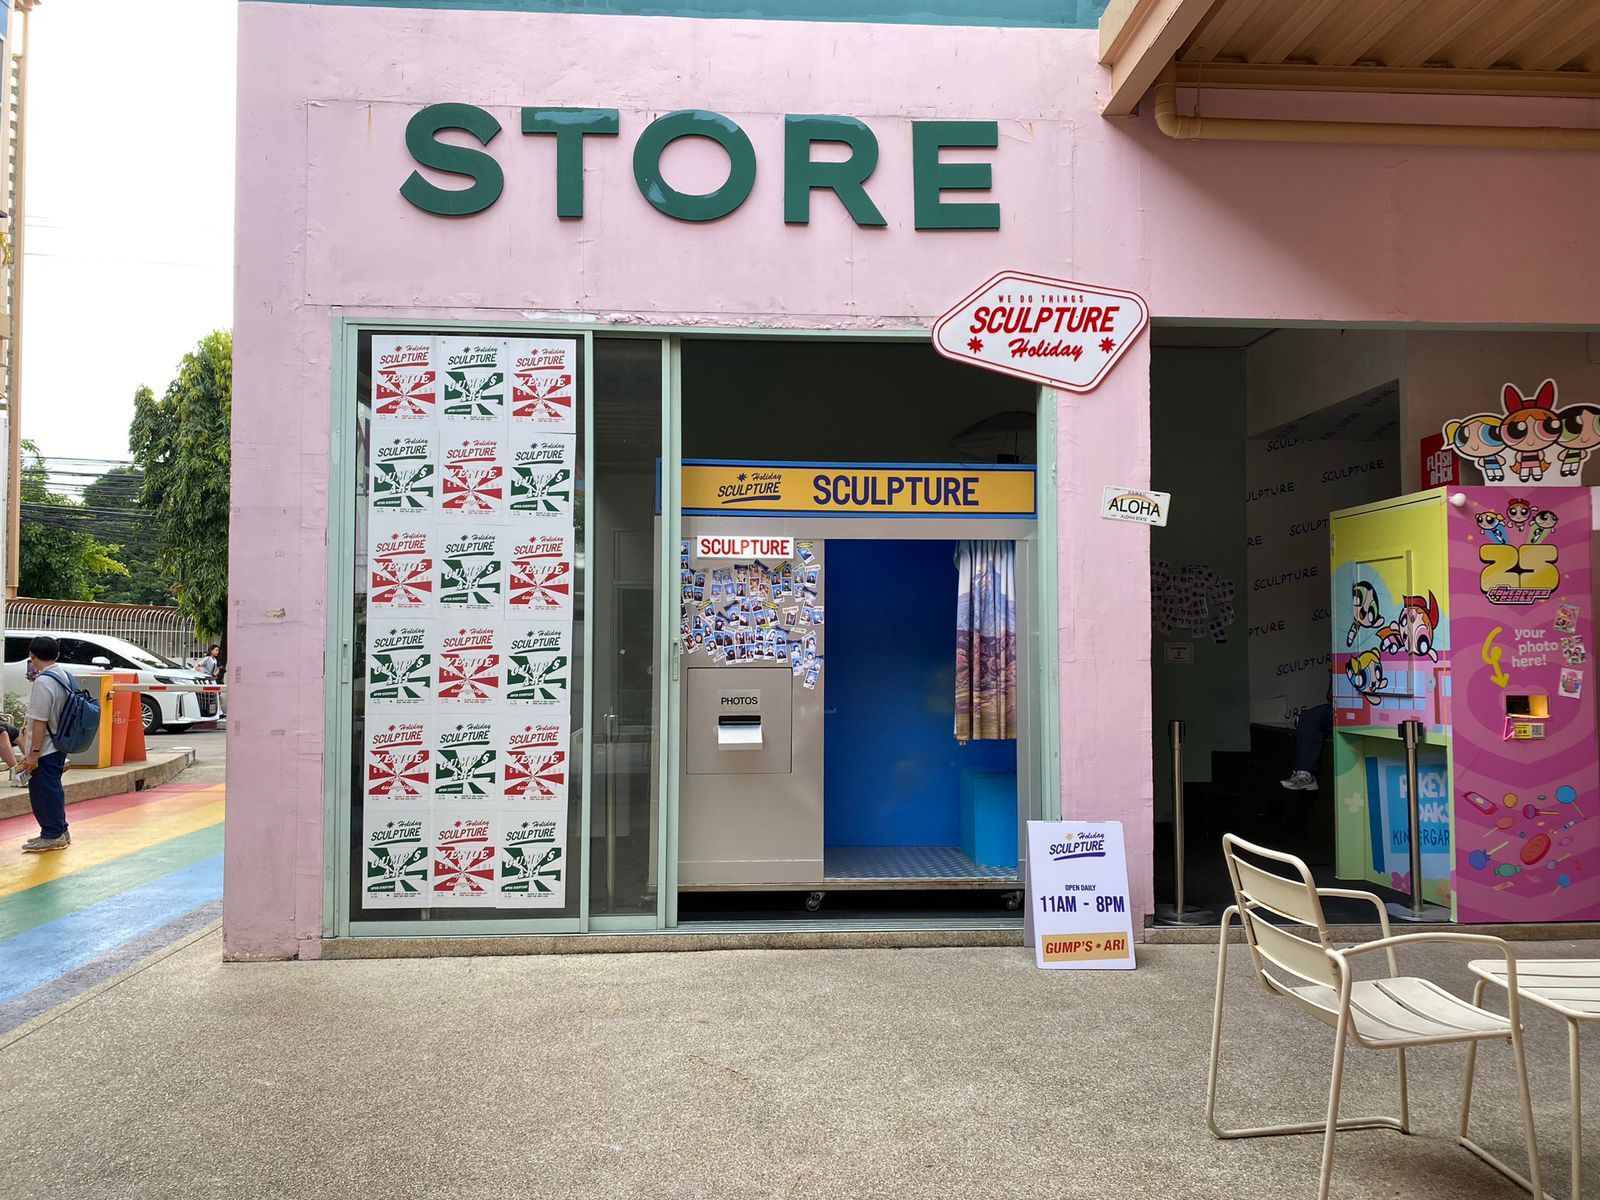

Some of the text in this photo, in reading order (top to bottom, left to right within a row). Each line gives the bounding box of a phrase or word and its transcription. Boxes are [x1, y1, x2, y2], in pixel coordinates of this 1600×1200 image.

[399, 102, 1001, 231] STORE
[998, 295, 1084, 303] WE DO THINGS
[969, 306, 1120, 334] SCULPTURE
[1008, 338, 1084, 362] Holiday
[380, 352, 429, 364] SCULPTURE
[448, 353, 497, 365] SCULPTURE
[516, 355, 565, 368] SCULPTURE
[404, 437, 429, 445] Holiday
[378, 444, 428, 457] SCULPTURE
[447, 446, 496, 459] SCULPTURE
[515, 449, 564, 461] SCULPTURE
[751, 472, 782, 481] Holiday
[1320, 458, 1385, 483] SCULPTURE
[717, 482, 781, 497] SCULPTURE
[812, 475, 980, 506] SCULPTURE
[1108, 498, 1160, 517] ALOHA
[402, 532, 427, 540] Holiday
[471, 533, 496, 541] Holiday
[376, 539, 426, 552] SCULPTURE
[445, 540, 495, 553] SCULPTURE
[514, 542, 563, 555] SCULPTURE
[701, 538, 790, 555] SCULPTURE
[1479, 544, 1560, 593] 25
[1253, 566, 1318, 591] SCULPTURE
[537, 629, 562, 637] Holiday
[1514, 628, 1546, 641] your
[374, 634, 425, 648] SCULPTURE
[443, 635, 493, 648] SCULPTURE
[511, 636, 561, 649] SCULPTURE
[1519, 641, 1559, 655] photo
[1511, 654, 1547, 668] here!
[721, 696, 758, 706] PHOTOS
[399, 723, 424, 731] Holiday
[535, 724, 560, 732] Holiday
[372, 731, 423, 744] SCULPTURE
[440, 730, 490, 743] SCULPTURE
[509, 732, 559, 745] SCULPTURE
[1399, 771, 1449, 799] PKEY
[464, 819, 490, 827] Holiday
[532, 820, 556, 828] Holiday
[371, 827, 422, 841] SCULPTURE
[438, 827, 488, 840] SCULPTURE
[506, 827, 556, 841] SCULPTURE
[1077, 832, 1105, 840] Holiday
[1049, 840, 1105, 856] SCULPTURE
[1040, 896, 1077, 912] 11AM
[1096, 896, 1125, 912] 8PM
[1045, 939, 1125, 954] GUMP'S ARI
